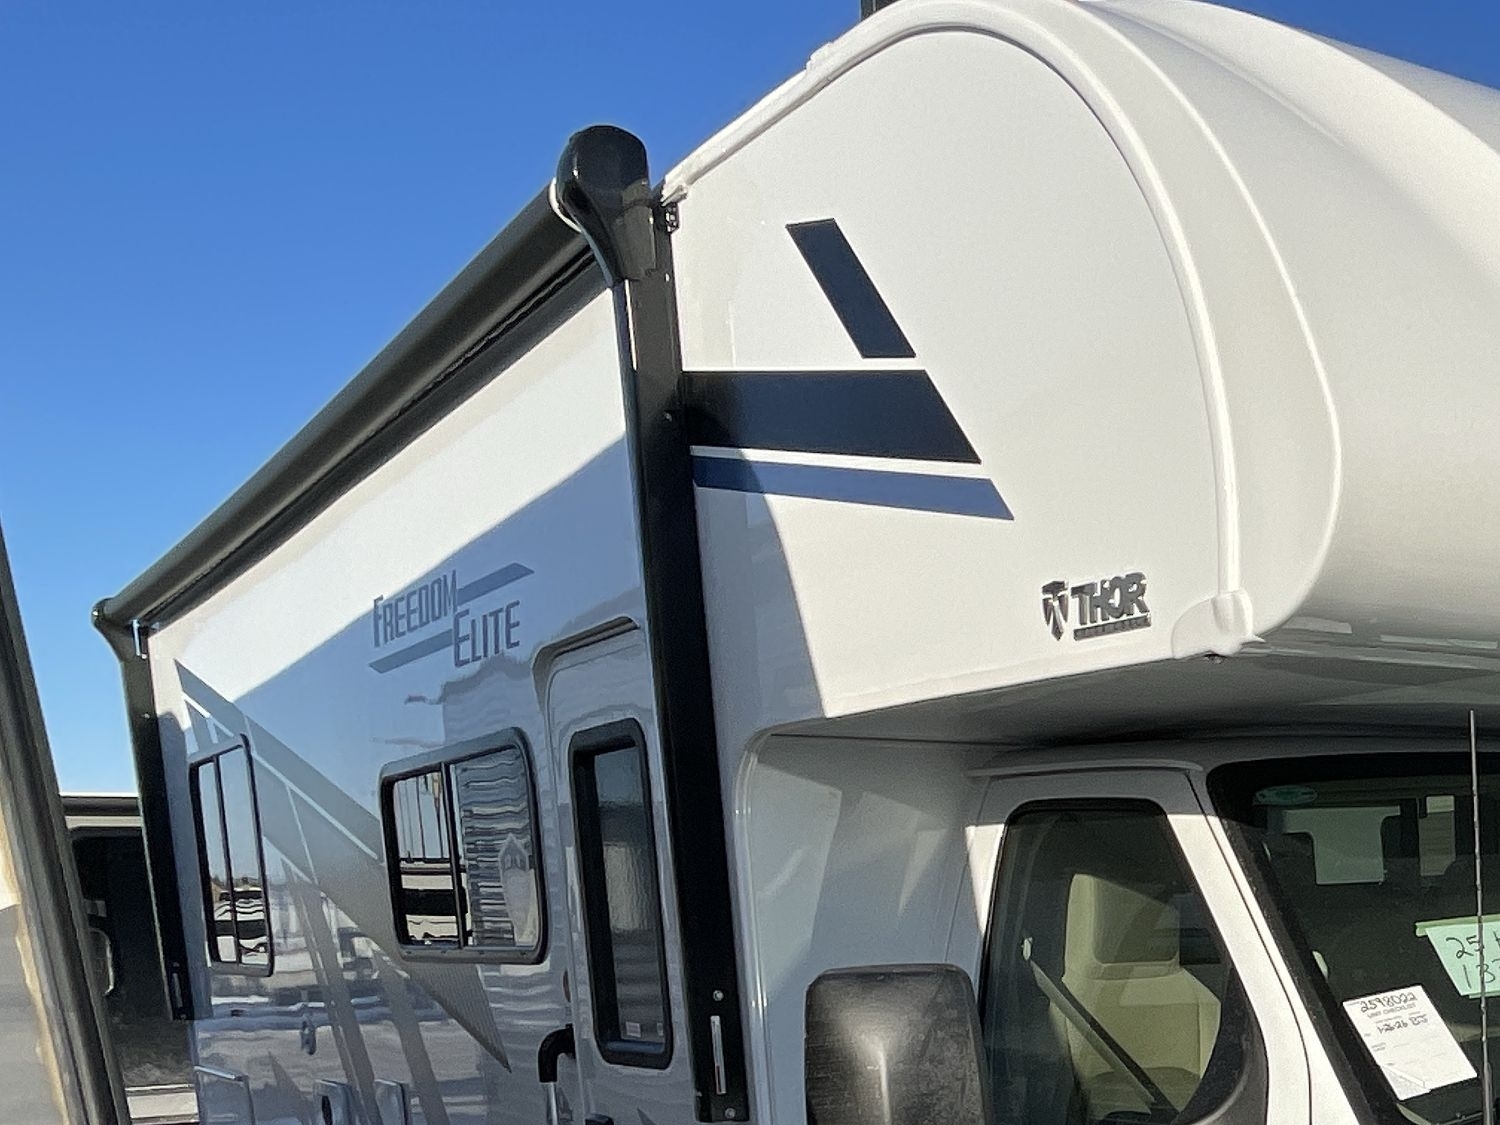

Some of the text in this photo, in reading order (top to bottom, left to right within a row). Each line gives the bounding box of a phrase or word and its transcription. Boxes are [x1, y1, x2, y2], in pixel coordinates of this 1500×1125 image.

[373, 569, 459, 648] FREEDOM
[1070, 571, 1150, 626] THOR
[453, 599, 521, 668] ELITE
[1445, 934, 1485, 960] 25
